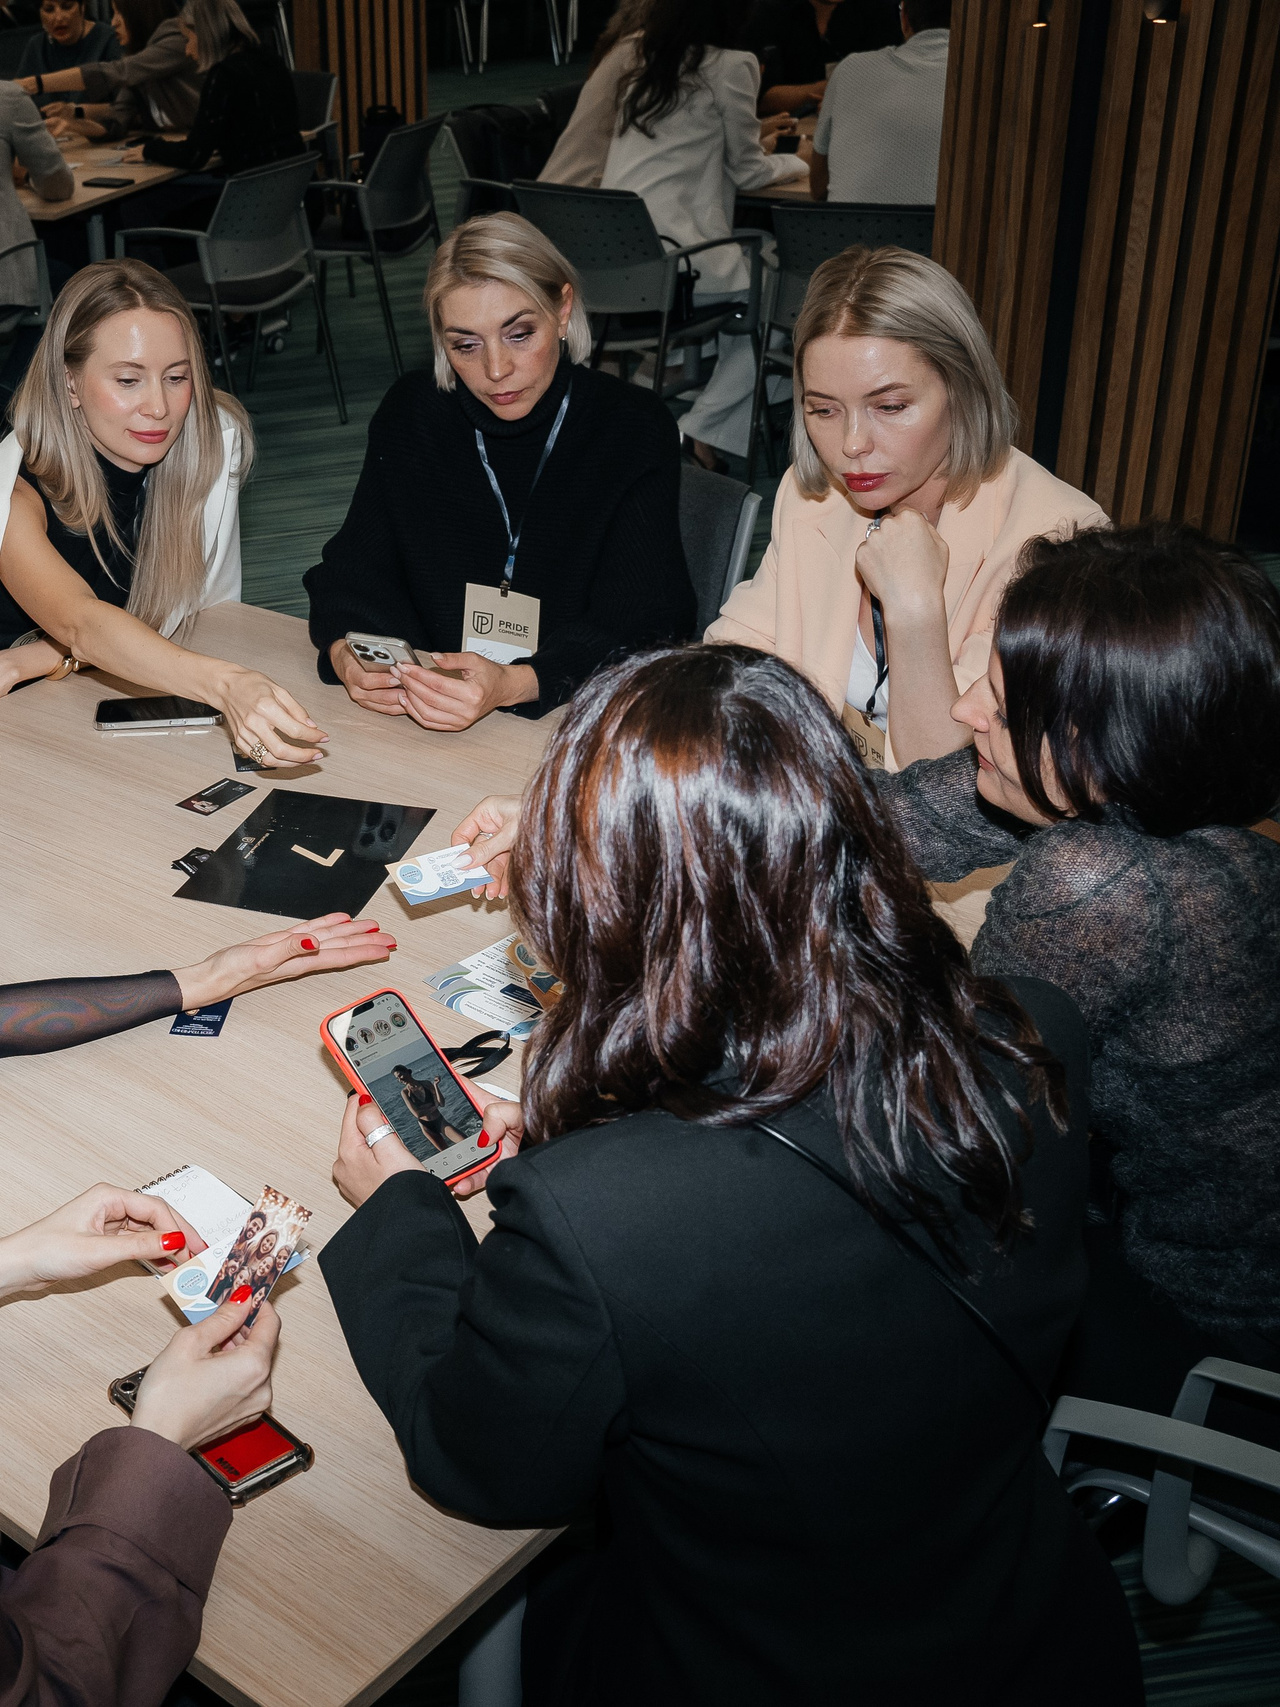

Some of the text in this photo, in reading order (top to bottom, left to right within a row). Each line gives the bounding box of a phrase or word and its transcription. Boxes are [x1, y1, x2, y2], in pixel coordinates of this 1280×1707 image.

[498, 620, 529, 634] PRIDE
[498, 629, 529, 639] COMMUNITY
[871, 748, 885, 762] PRI
[215, 1457, 240, 1476] МИР
